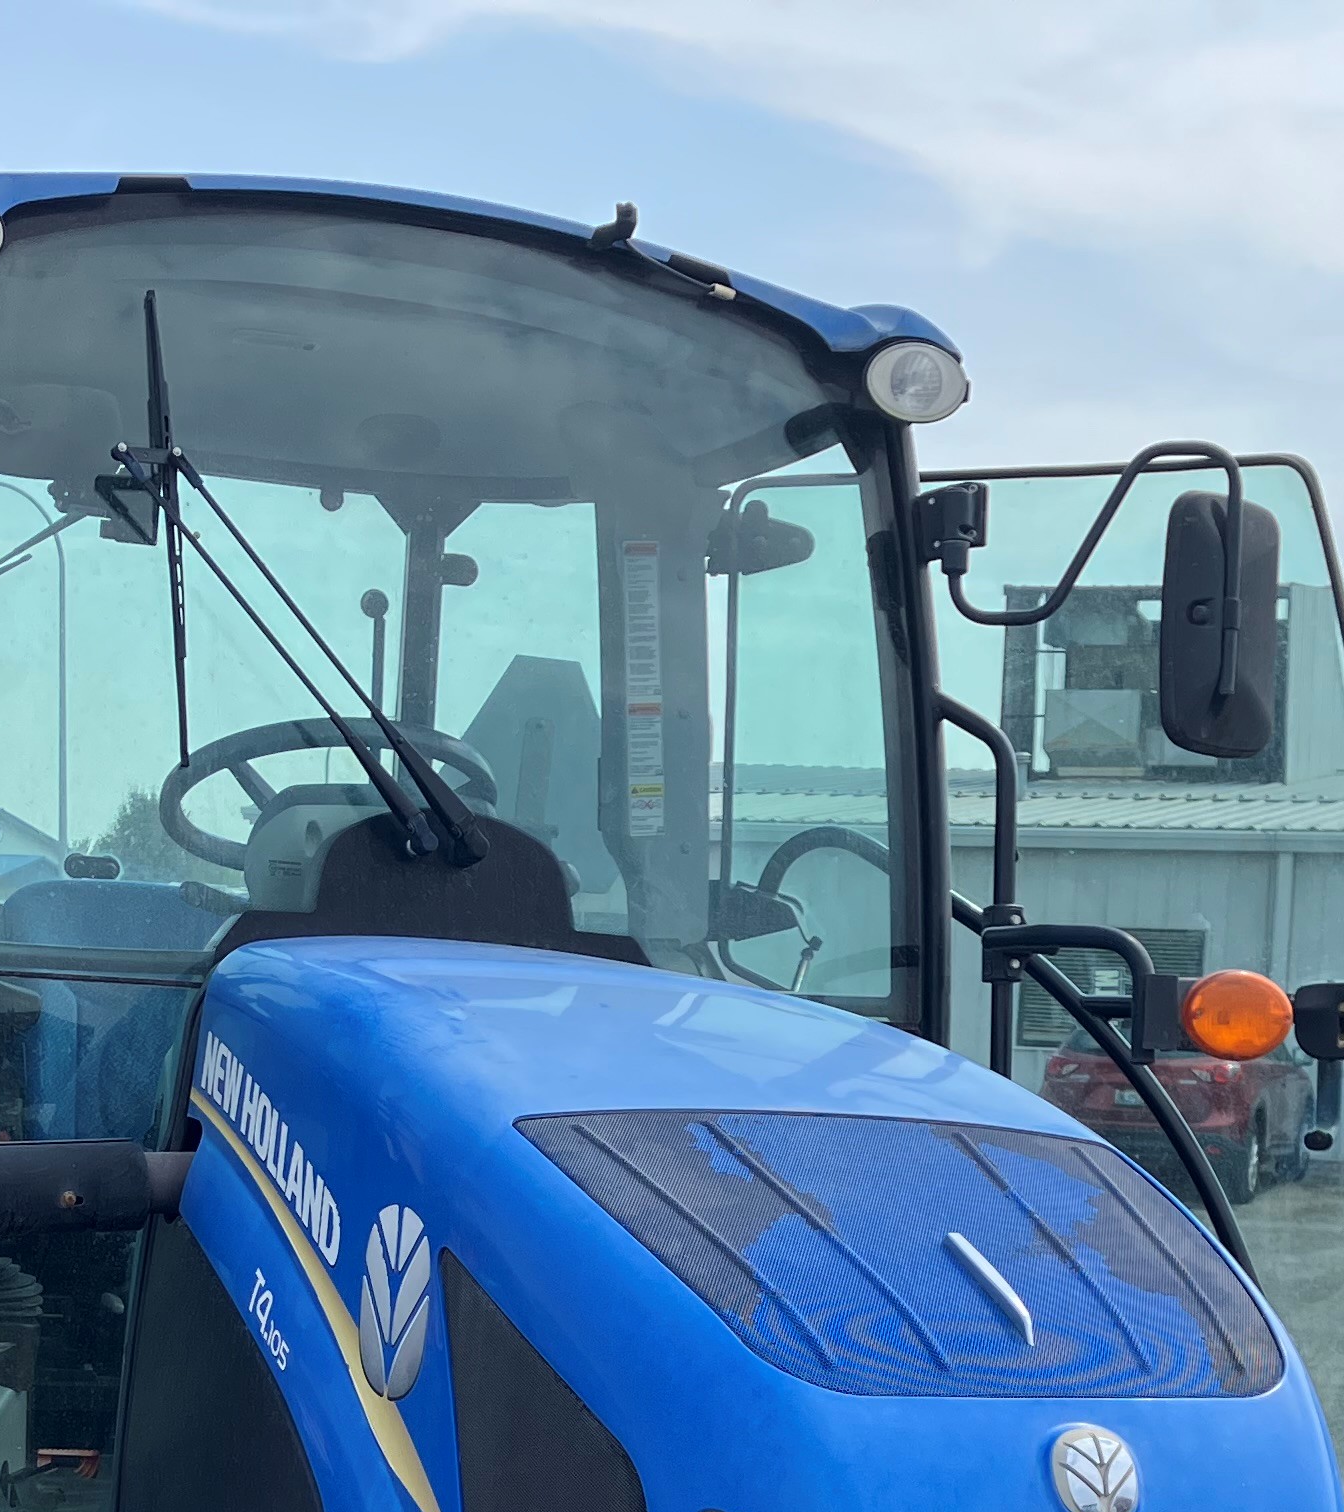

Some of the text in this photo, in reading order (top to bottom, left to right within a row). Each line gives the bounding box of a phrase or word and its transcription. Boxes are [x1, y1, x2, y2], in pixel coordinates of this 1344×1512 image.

[201, 1030, 341, 1266] NEW HOLLAND
[249, 1267, 290, 1371] T4.105
